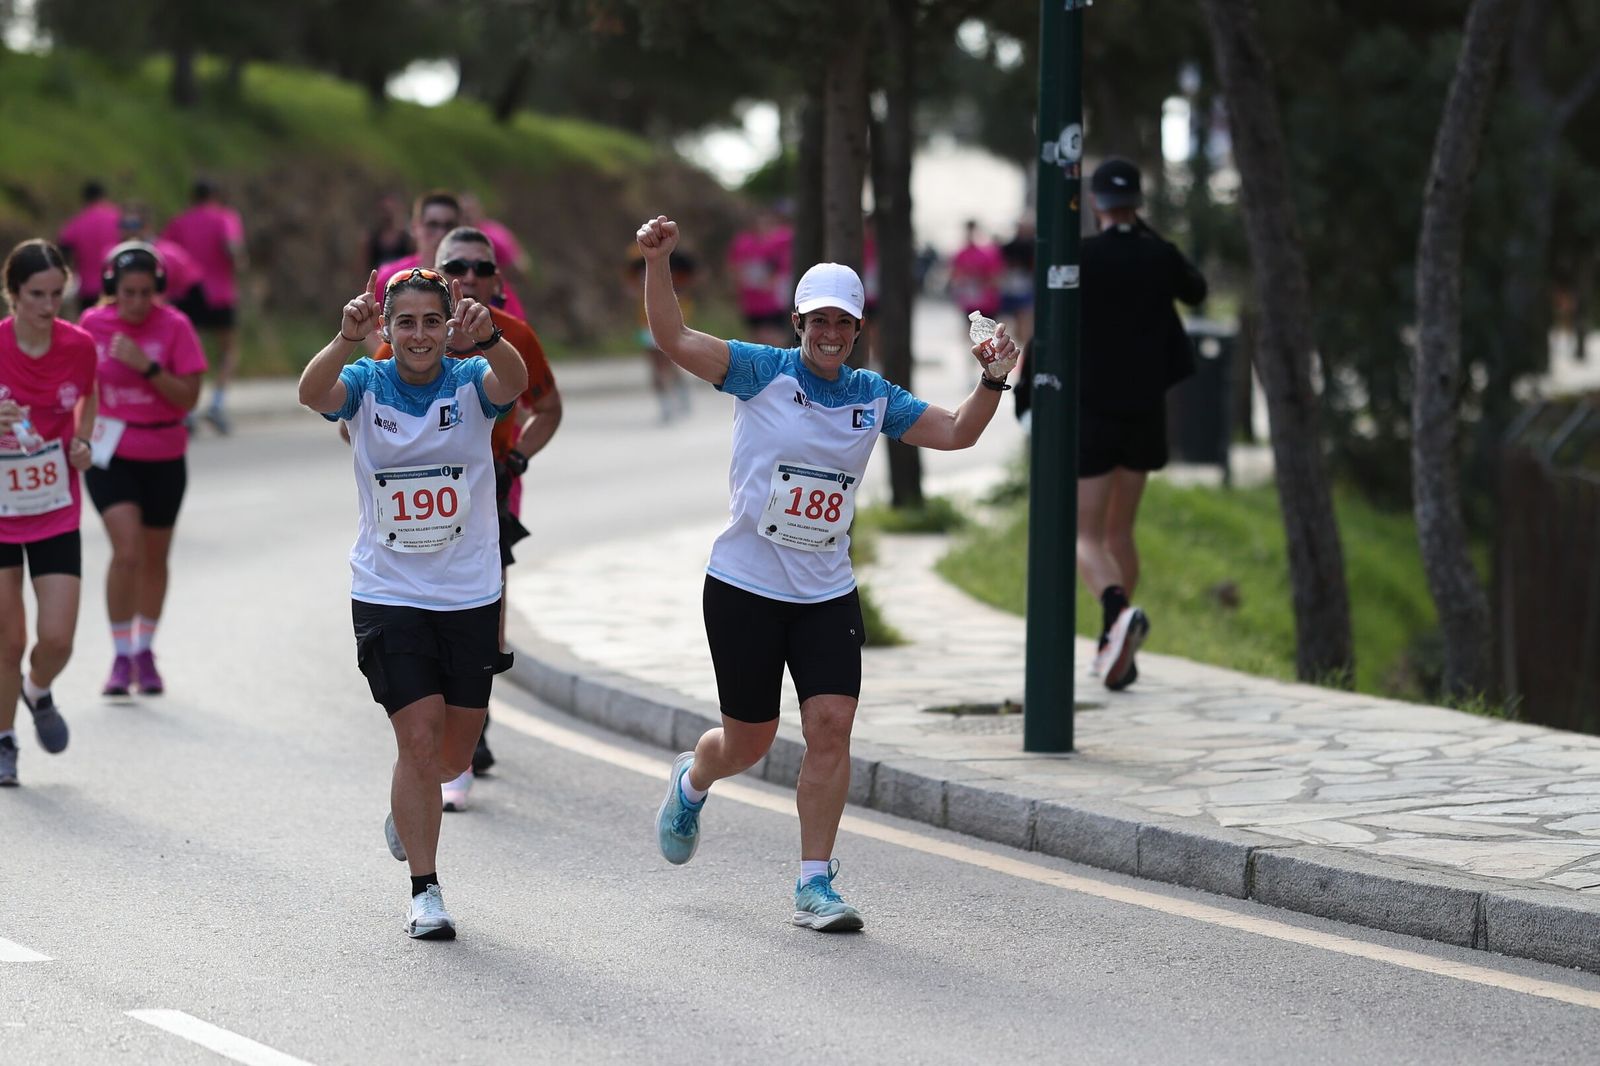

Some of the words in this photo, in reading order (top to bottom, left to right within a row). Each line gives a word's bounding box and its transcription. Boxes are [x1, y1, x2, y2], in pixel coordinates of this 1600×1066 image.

[383, 419, 397, 428] RUN
[384, 426, 398, 434] PRO
[7, 462, 57, 491] 138
[392, 486, 458, 521] 190
[784, 486, 844, 523] 188
